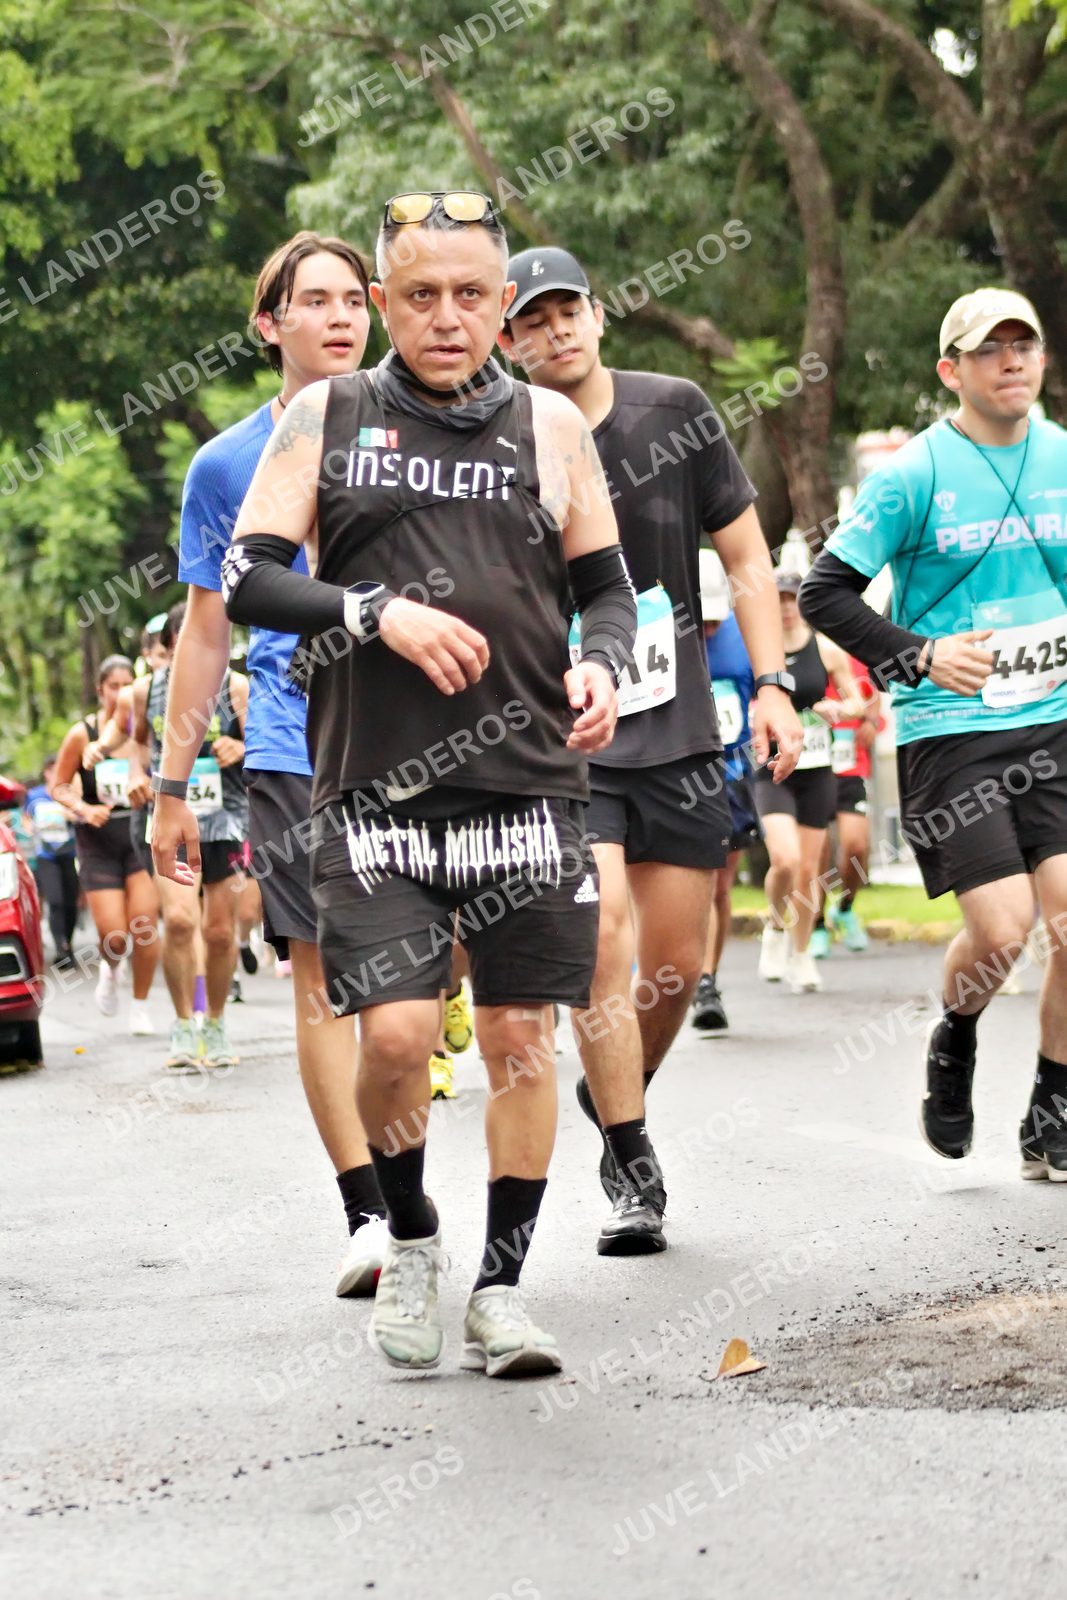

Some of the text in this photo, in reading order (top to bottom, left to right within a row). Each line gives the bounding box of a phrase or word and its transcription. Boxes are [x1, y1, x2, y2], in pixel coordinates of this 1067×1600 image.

[346, 450, 515, 500] INSOLENT
[934, 513, 1067, 553] PERDUR
[991, 635, 1067, 680] 4425
[342, 797, 562, 895] METAL MULISHA
